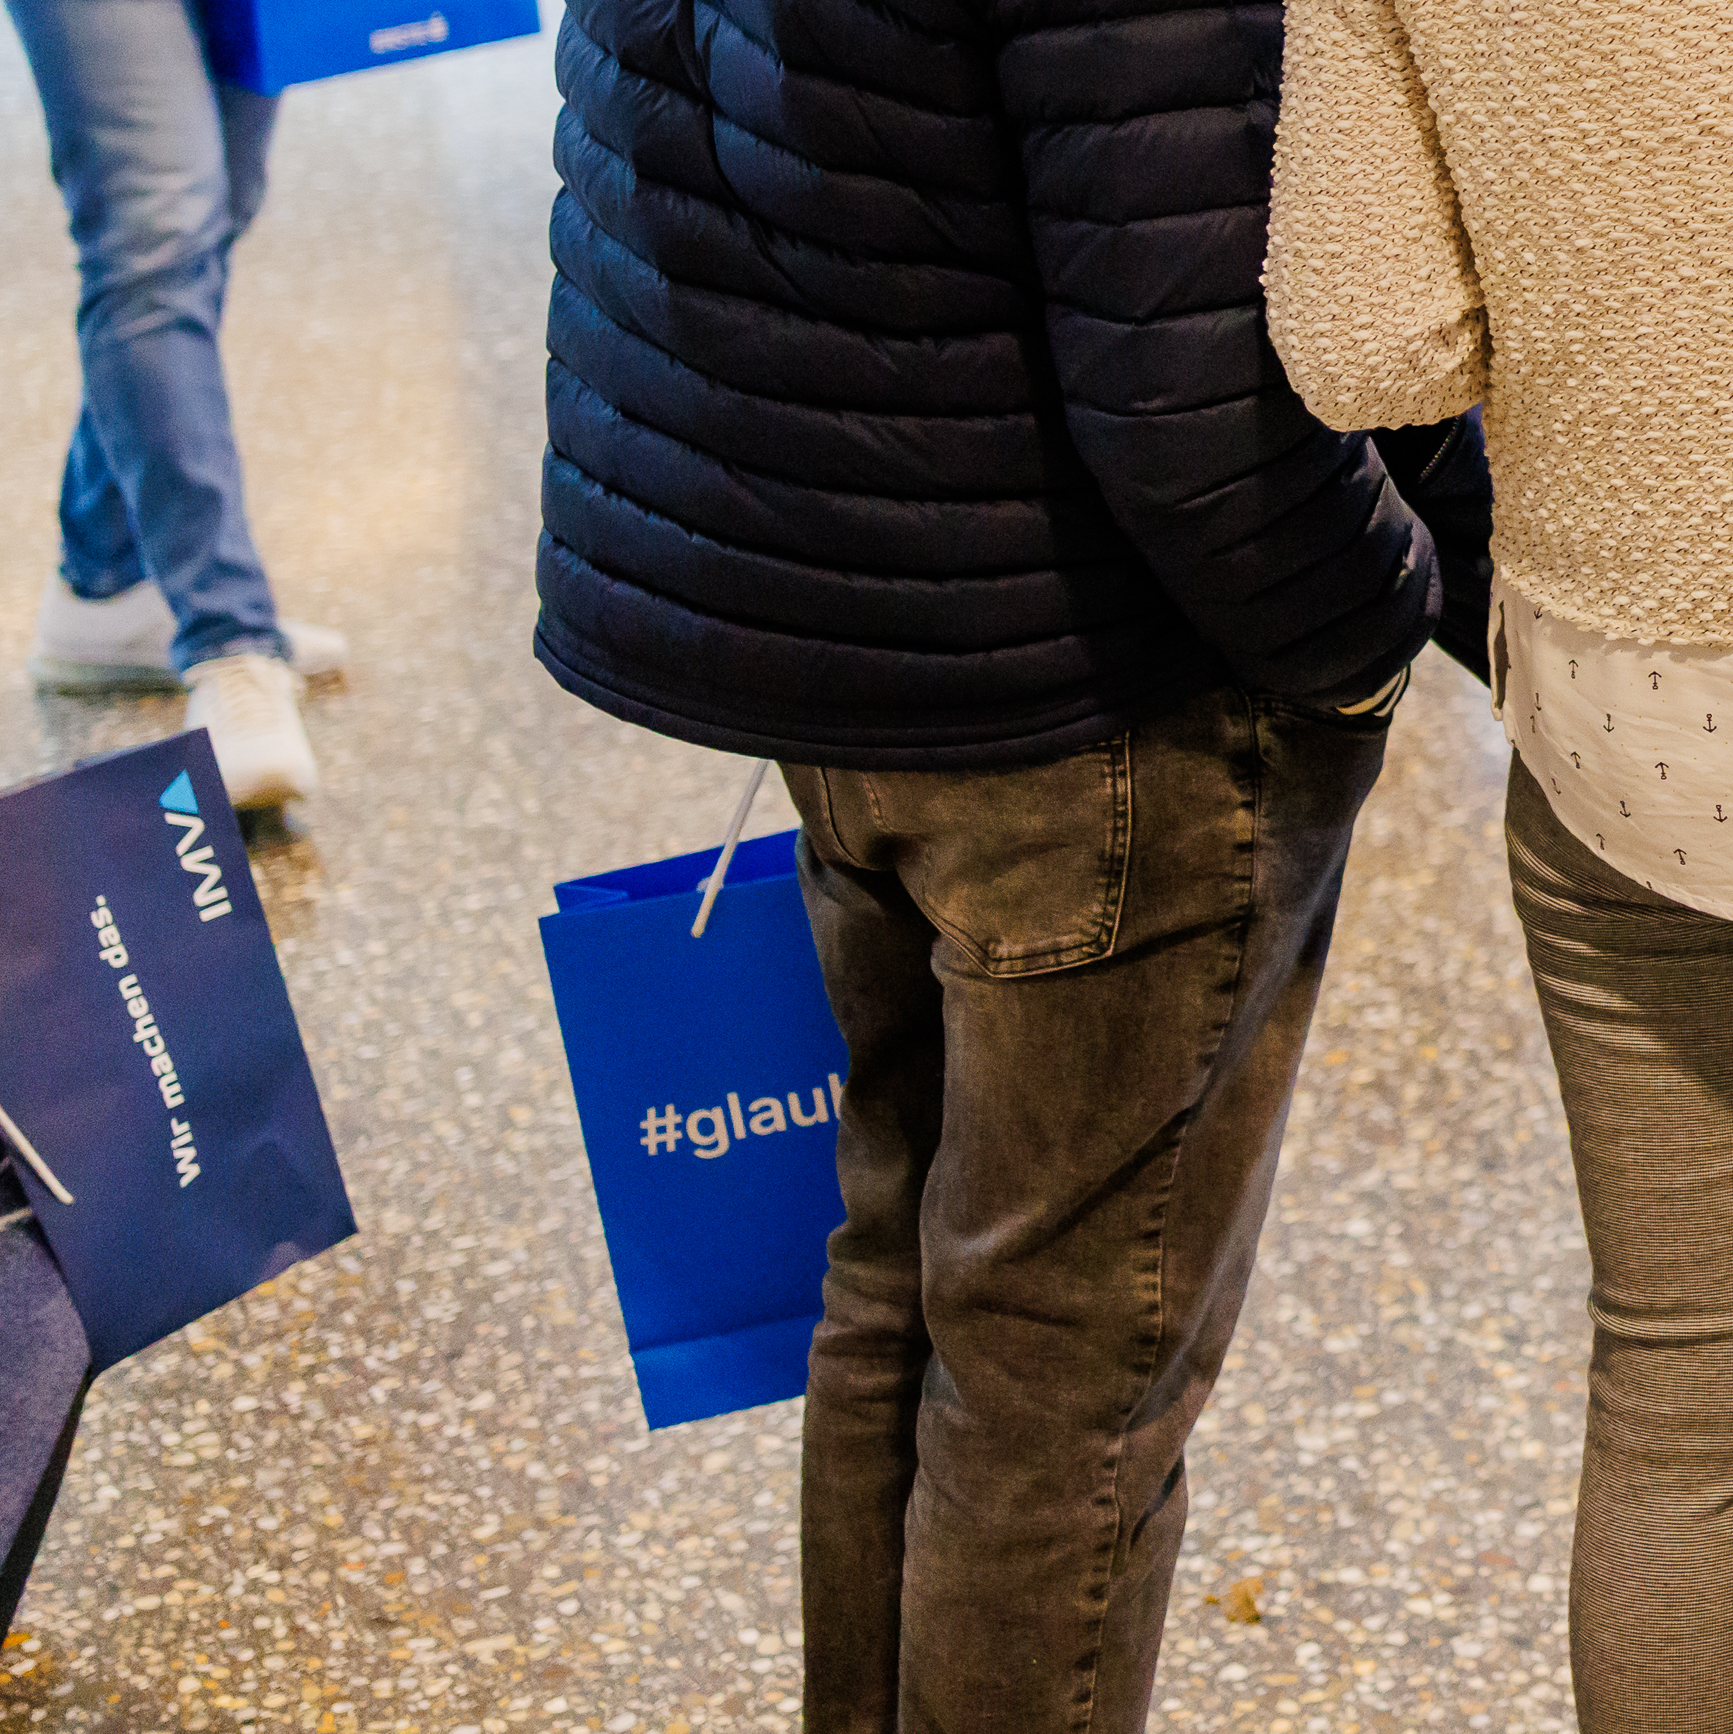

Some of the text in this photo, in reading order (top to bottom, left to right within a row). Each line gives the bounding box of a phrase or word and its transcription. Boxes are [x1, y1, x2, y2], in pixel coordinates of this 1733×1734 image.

[90, 894, 201, 1188] Wir machen das.
